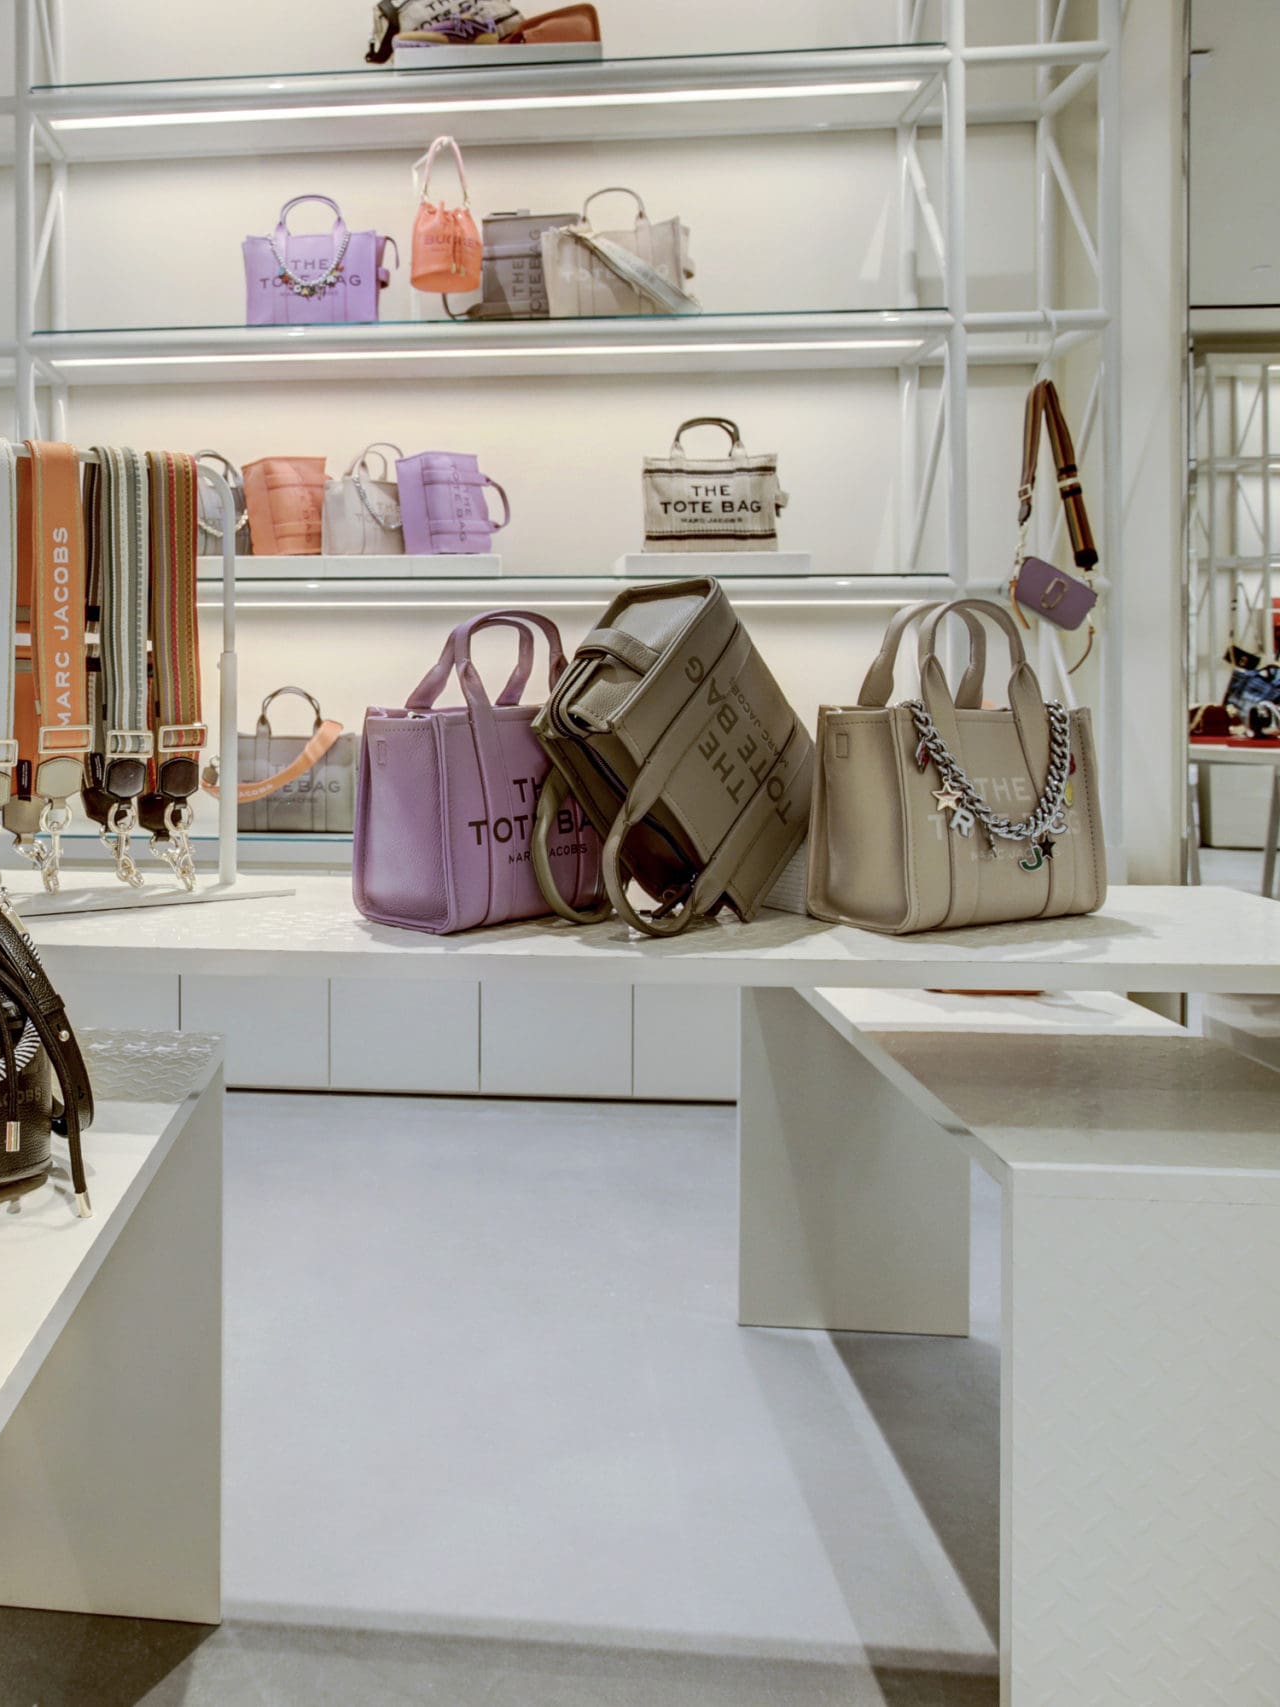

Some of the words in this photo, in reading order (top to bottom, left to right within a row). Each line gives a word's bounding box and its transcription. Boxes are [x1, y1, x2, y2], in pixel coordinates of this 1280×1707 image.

[291, 259, 330, 270] THE
[512, 259, 524, 297] THE
[529, 272, 542, 316] OTE
[691, 485, 731, 497] THE
[660, 500, 713, 514] TOTE
[722, 500, 762, 514] BAG
[53, 527, 69, 641] JACOBS
[55, 652, 72, 727] MARC
[684, 655, 740, 735] BAG
[698, 731, 745, 804] THE
[736, 734, 793, 826] TOTE
[239, 783, 274, 798] ACOBS
[298, 780, 342, 794] BAG
[512, 776, 547, 803] TH
[974, 777, 1031, 801] THE
[557, 808, 595, 835] BA
[508, 851, 531, 865] MAR
[550, 843, 588, 858] ACOBS
